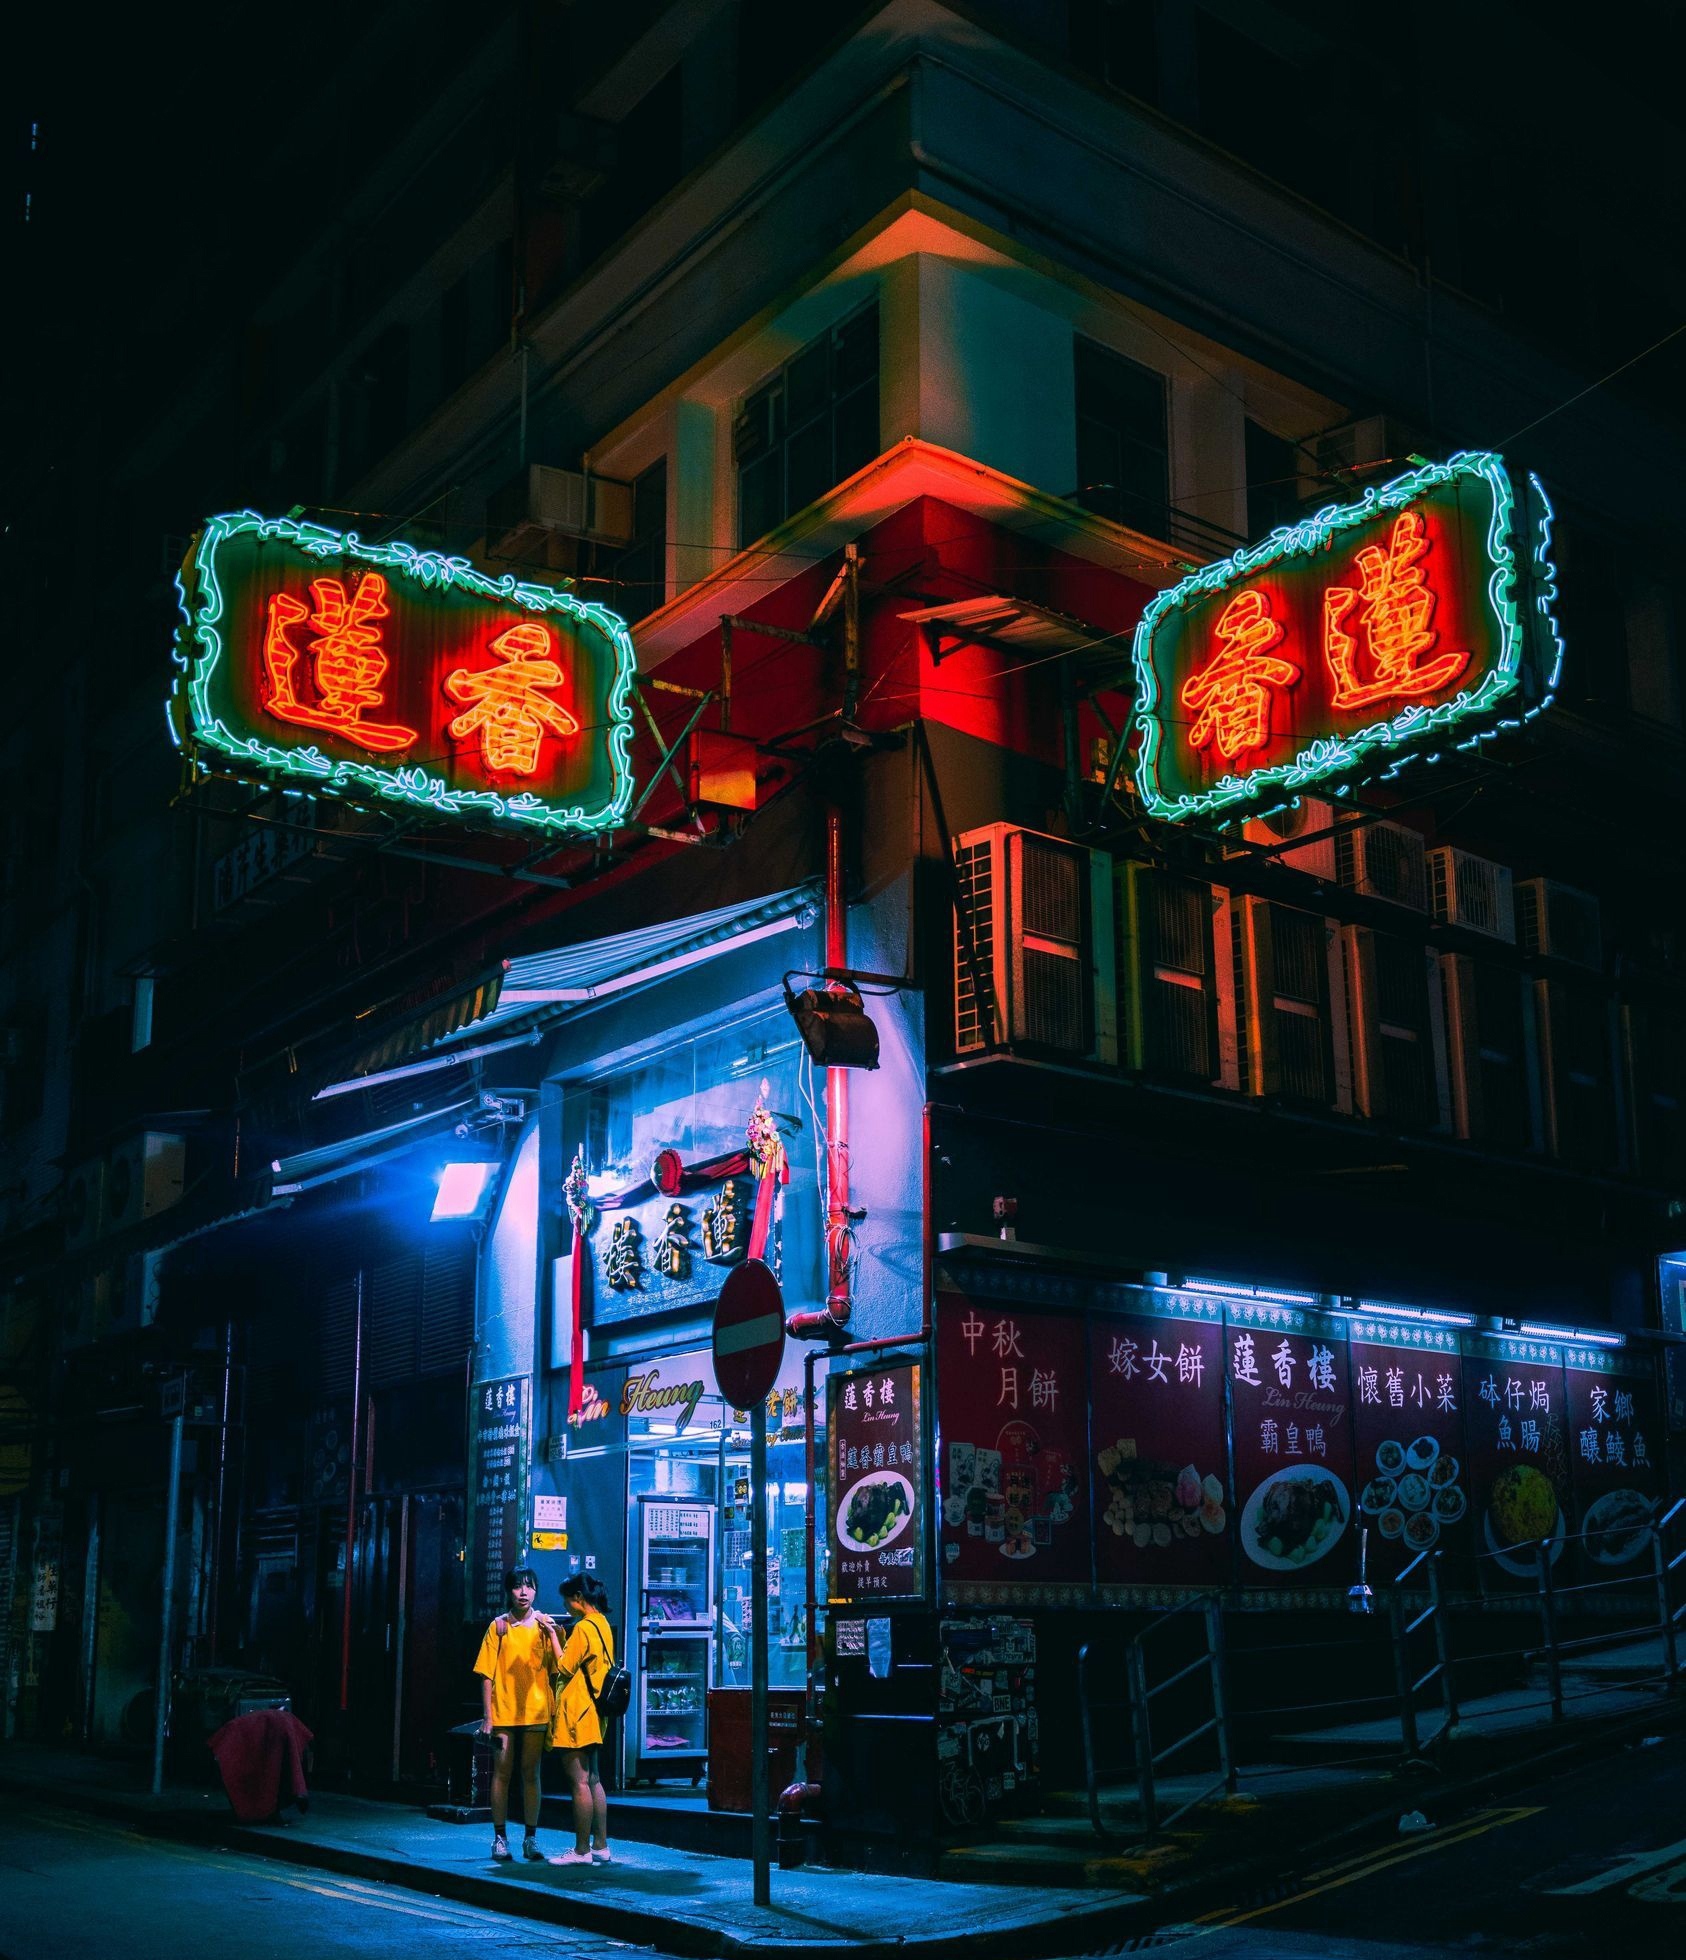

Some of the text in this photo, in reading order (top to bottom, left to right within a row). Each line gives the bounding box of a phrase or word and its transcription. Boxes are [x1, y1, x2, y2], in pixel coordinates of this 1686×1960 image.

[265, 573, 579, 774] 蓮香
[961, 1311, 1024, 1358] 中秋
[1107, 1336, 1205, 1388] 嫁女餅
[1232, 1333, 1337, 1392] 蓮香樓
[620, 1369, 705, 1435] Heung
[844, 1378, 895, 1411] 蓮香樓
[997, 1367, 1060, 1413] 月餅
[1262, 1387, 1345, 1427] Lin Heung
[1357, 1366, 1458, 1413] 懷舊小菜
[1478, 1373, 1550, 1414] 砵仔焗
[1590, 1385, 1634, 1426] 家鄉
[709, 1419, 722, 1430] 162
[861, 1409, 900, 1426] Lin Heung
[1260, 1419, 1326, 1457] 霸皇鴨
[1496, 1414, 1541, 1454] 魚腸
[847, 1440, 914, 1470] 蓮香霸皇鴨
[1579, 1426, 1652, 1468] 釀鯪魚
